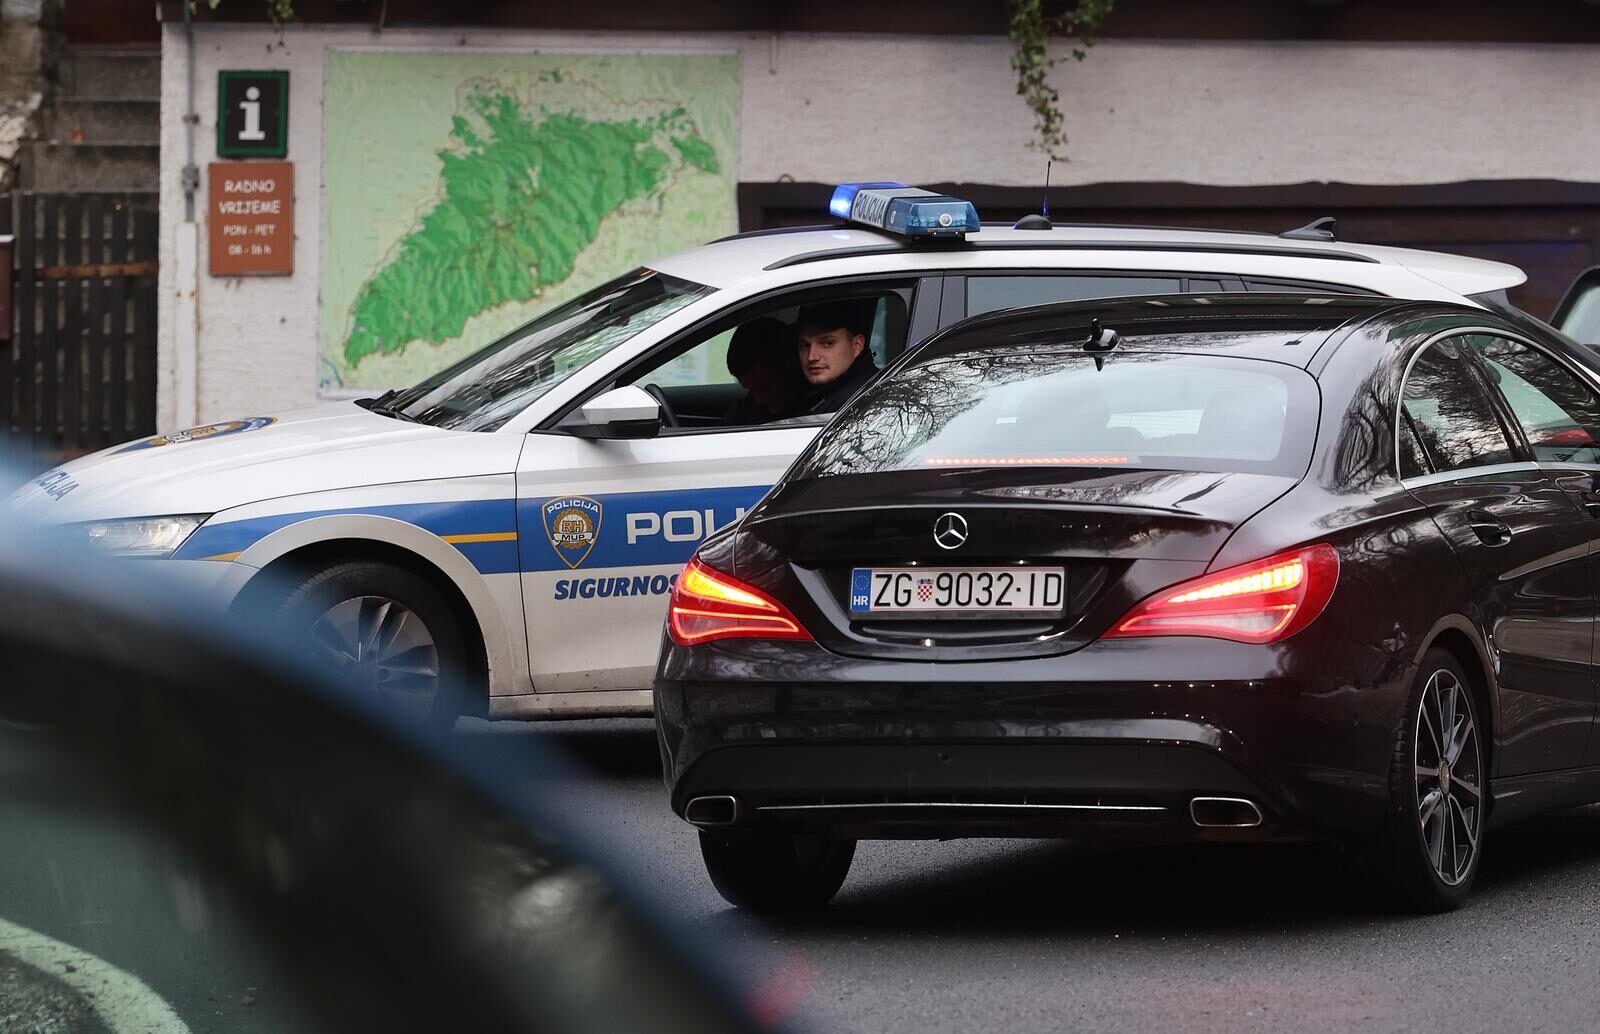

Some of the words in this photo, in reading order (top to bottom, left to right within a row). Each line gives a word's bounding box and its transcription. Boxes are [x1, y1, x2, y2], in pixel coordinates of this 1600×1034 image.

[224, 180, 276, 193] RADNO
[218, 200, 281, 214] VRIJEME
[255, 224, 276, 236] PET
[547, 500, 598, 514] POLICIJA
[562, 520, 584, 532] RH
[874, 573, 913, 607] ZG
[853, 595, 869, 606] HR
